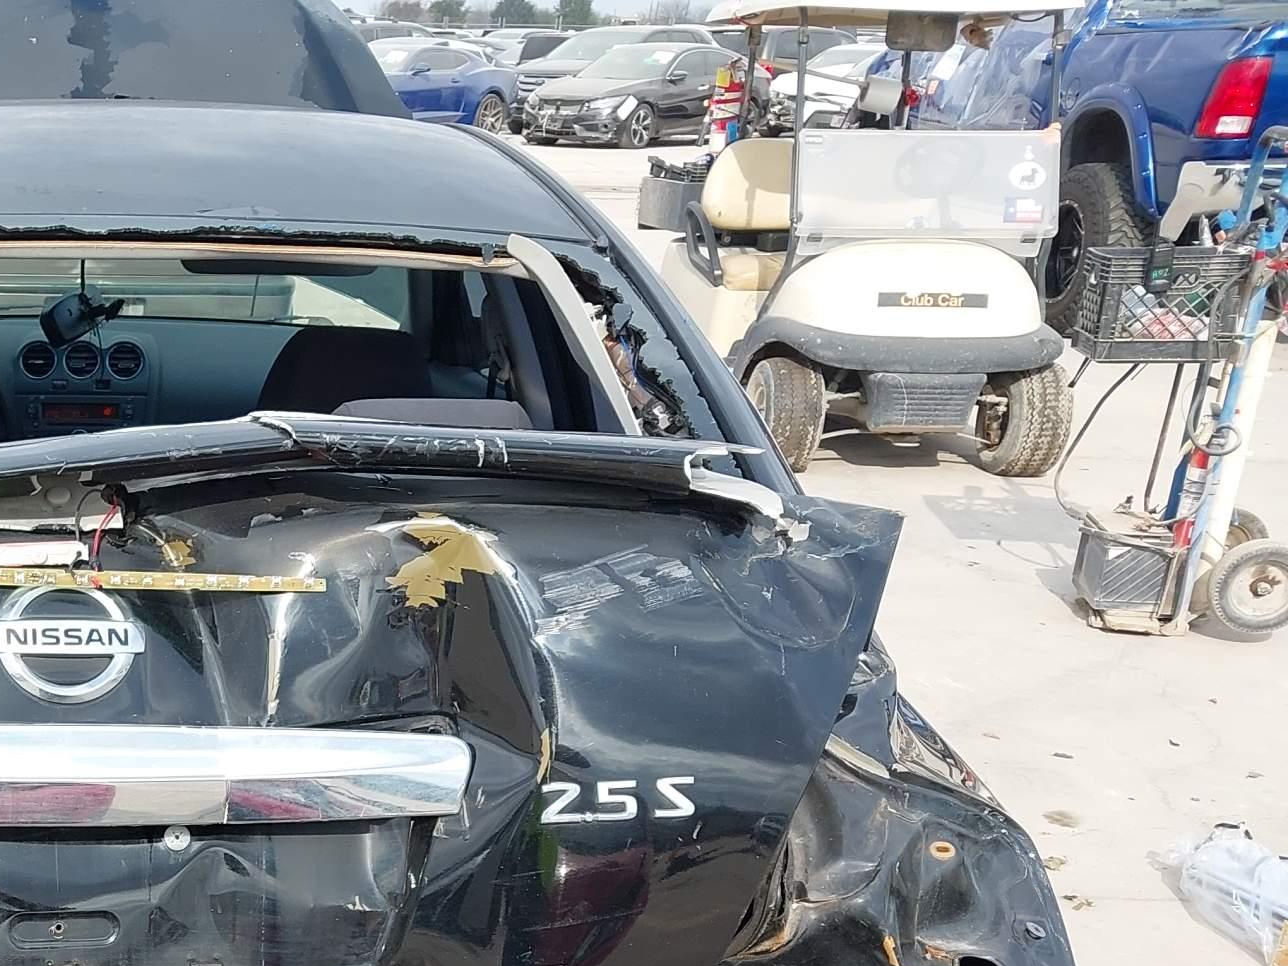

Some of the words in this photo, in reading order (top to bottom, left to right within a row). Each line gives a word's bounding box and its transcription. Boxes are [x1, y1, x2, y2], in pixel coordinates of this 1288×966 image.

[899, 292, 934, 307] Club
[937, 293, 965, 307] Car
[5, 627, 130, 647] NISSAN
[652, 775, 697, 819] S
